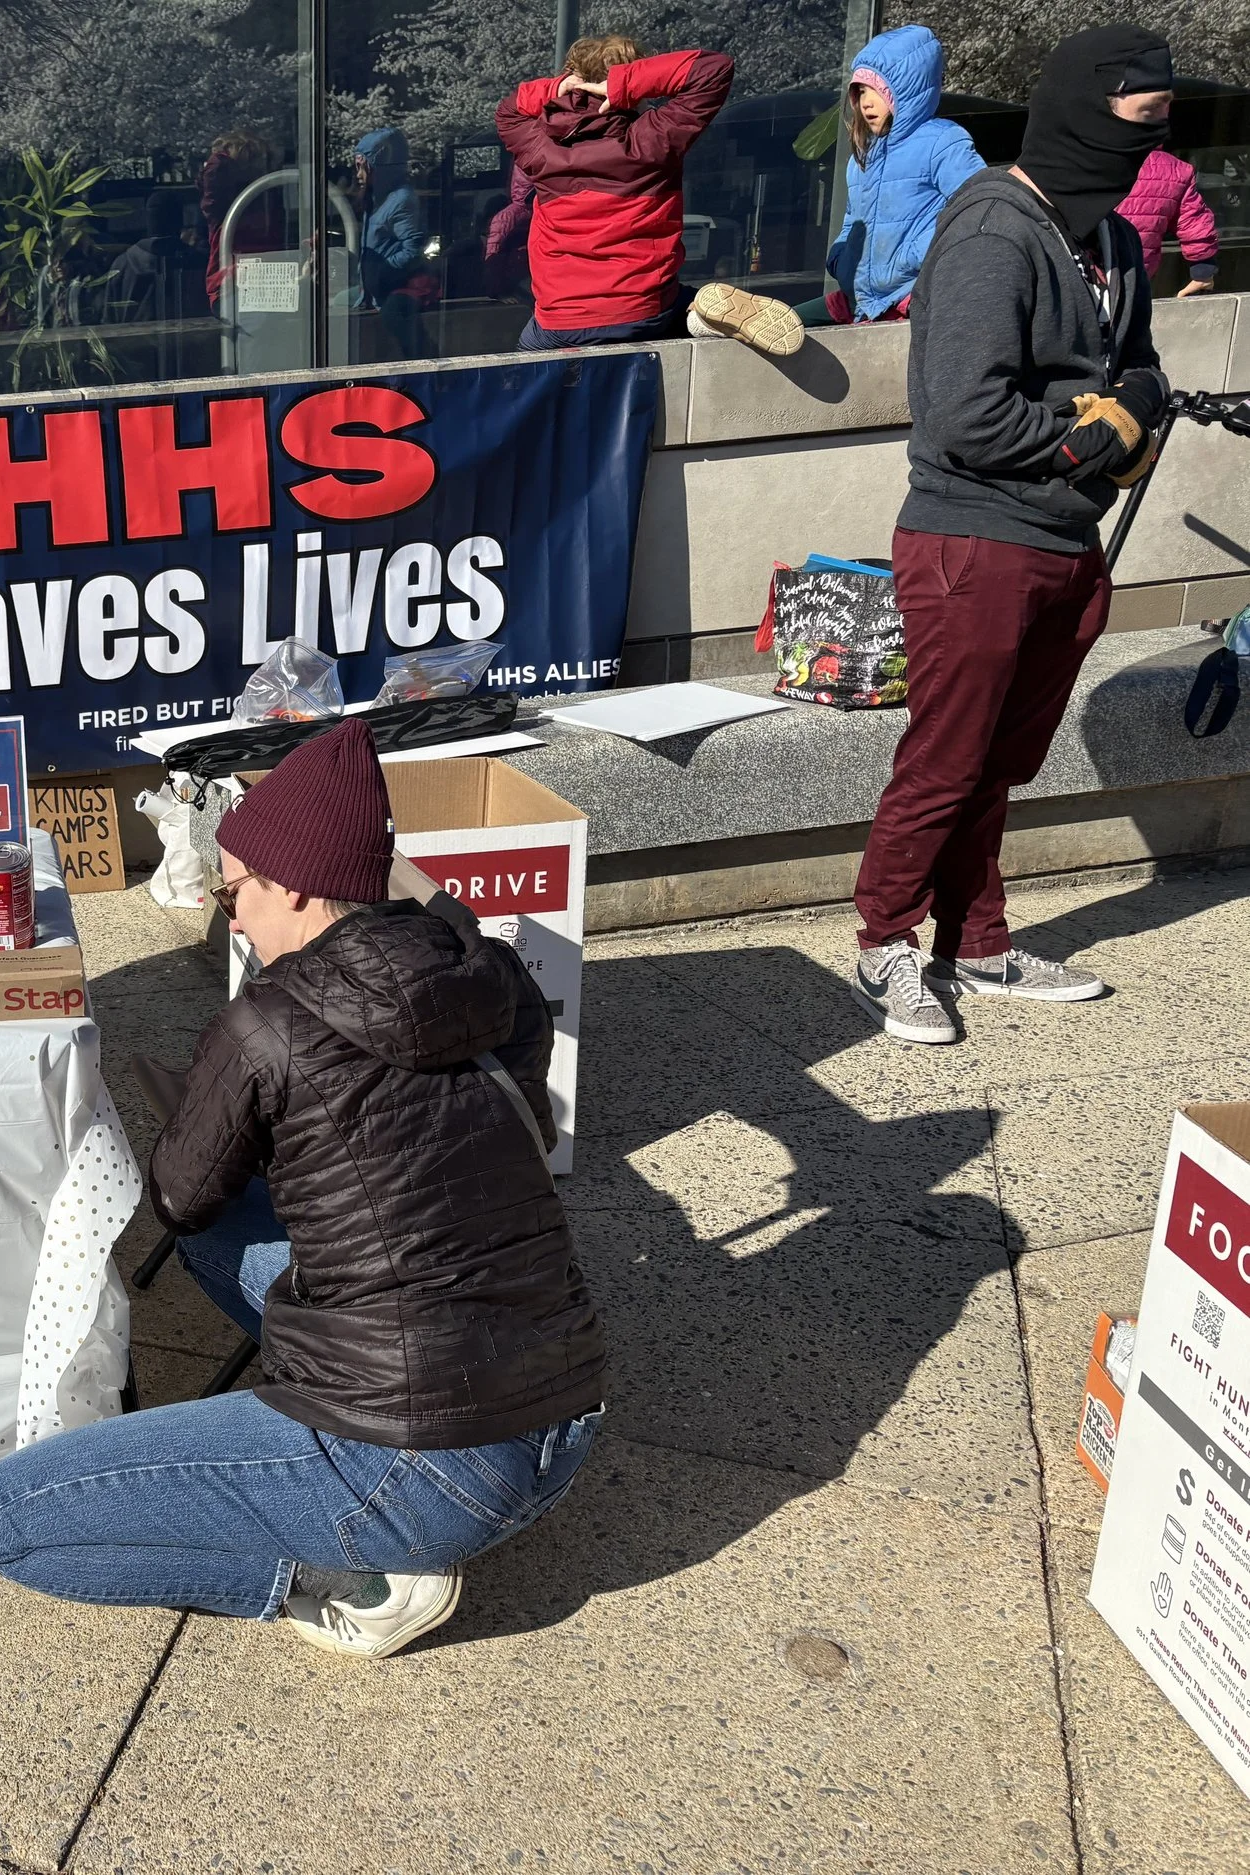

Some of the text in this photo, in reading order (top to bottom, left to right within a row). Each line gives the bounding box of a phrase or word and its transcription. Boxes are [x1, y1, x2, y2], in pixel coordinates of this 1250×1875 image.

[242, 531, 505, 667] Lives
[487, 657, 622, 687] HHS ALLIES
[78, 700, 204, 731] FIRED BUT
[33, 784, 108, 814] KINGS
[63, 850, 113, 880] ARS
[444, 871, 549, 900] DRIVE
[3, 987, 84, 1015] Stap
[1170, 1332, 1212, 1380] FIGHT
[1087, 1396, 1103, 1428] Top
[1209, 1391, 1219, 1408] in
[1082, 1424, 1108, 1467] CHICKEN
[1086, 1410, 1115, 1460] Ramen
[1205, 1444, 1233, 1480] Get
[1206, 1488, 1244, 1536] Donate
[1223, 1529, 1242, 1552] every
[1195, 1540, 1232, 1588] Donate
[1191, 1570, 1203, 1585] can
[1202, 1582, 1217, 1600] plan
[1221, 1602, 1236, 1621] food
[1199, 1568, 1224, 1597] addition
[1196, 1587, 1213, 1608] place
[1220, 1613, 1246, 1645] worship.
[1178, 1628, 1192, 1649] front
[1183, 1600, 1248, 1681] Donate Time
[1180, 1620, 1198, 1644] Serve
[1211, 1657, 1240, 1692] volunteer
[1150, 1628, 1171, 1657] Please
[1170, 1653, 1193, 1684] Return
[1193, 1678, 1208, 1701] This
[1207, 1697, 1223, 1720] Box
[1222, 1714, 1230, 1728] to
[1168, 1665, 1184, 1687] Road
